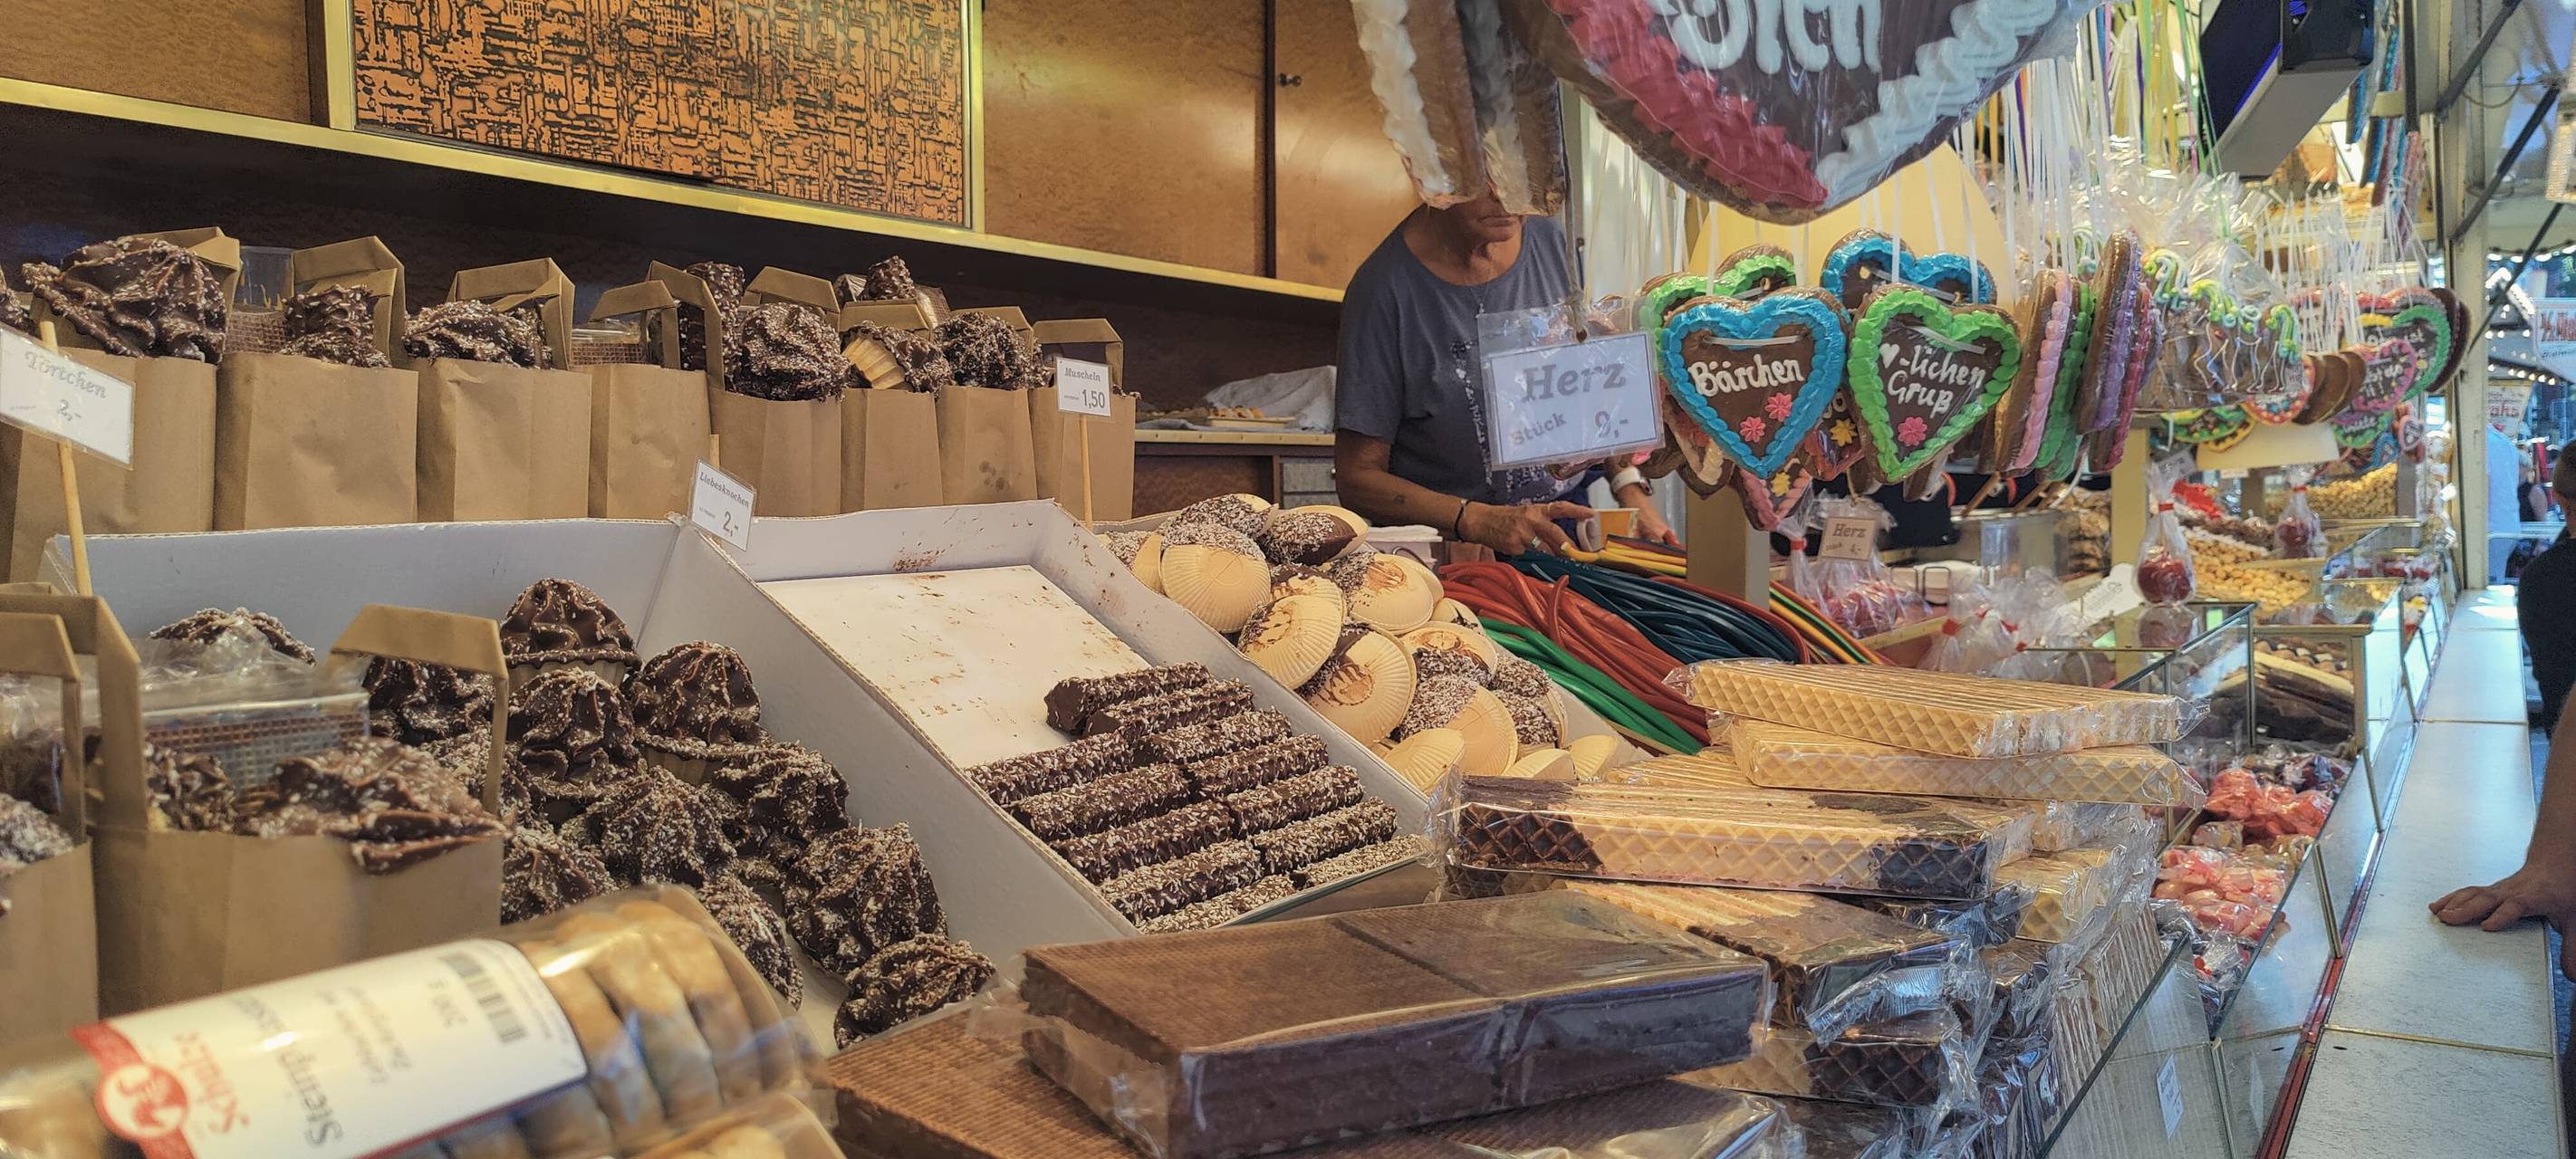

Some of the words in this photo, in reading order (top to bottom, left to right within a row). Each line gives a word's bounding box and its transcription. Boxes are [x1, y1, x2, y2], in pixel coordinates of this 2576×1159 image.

[24, 350, 108, 398] Törtchen
[1064, 367, 1101, 382] Muscheln
[1522, 362, 1627, 403] Herz
[1687, 353, 1804, 397] Bärchen
[1081, 389, 1105, 408] 1,50
[1888, 369, 1954, 419] Gruß
[699, 471, 750, 508] Liebesknochen
[722, 511, 739, 537] 2,-
[1832, 523, 1867, 538] Herz
